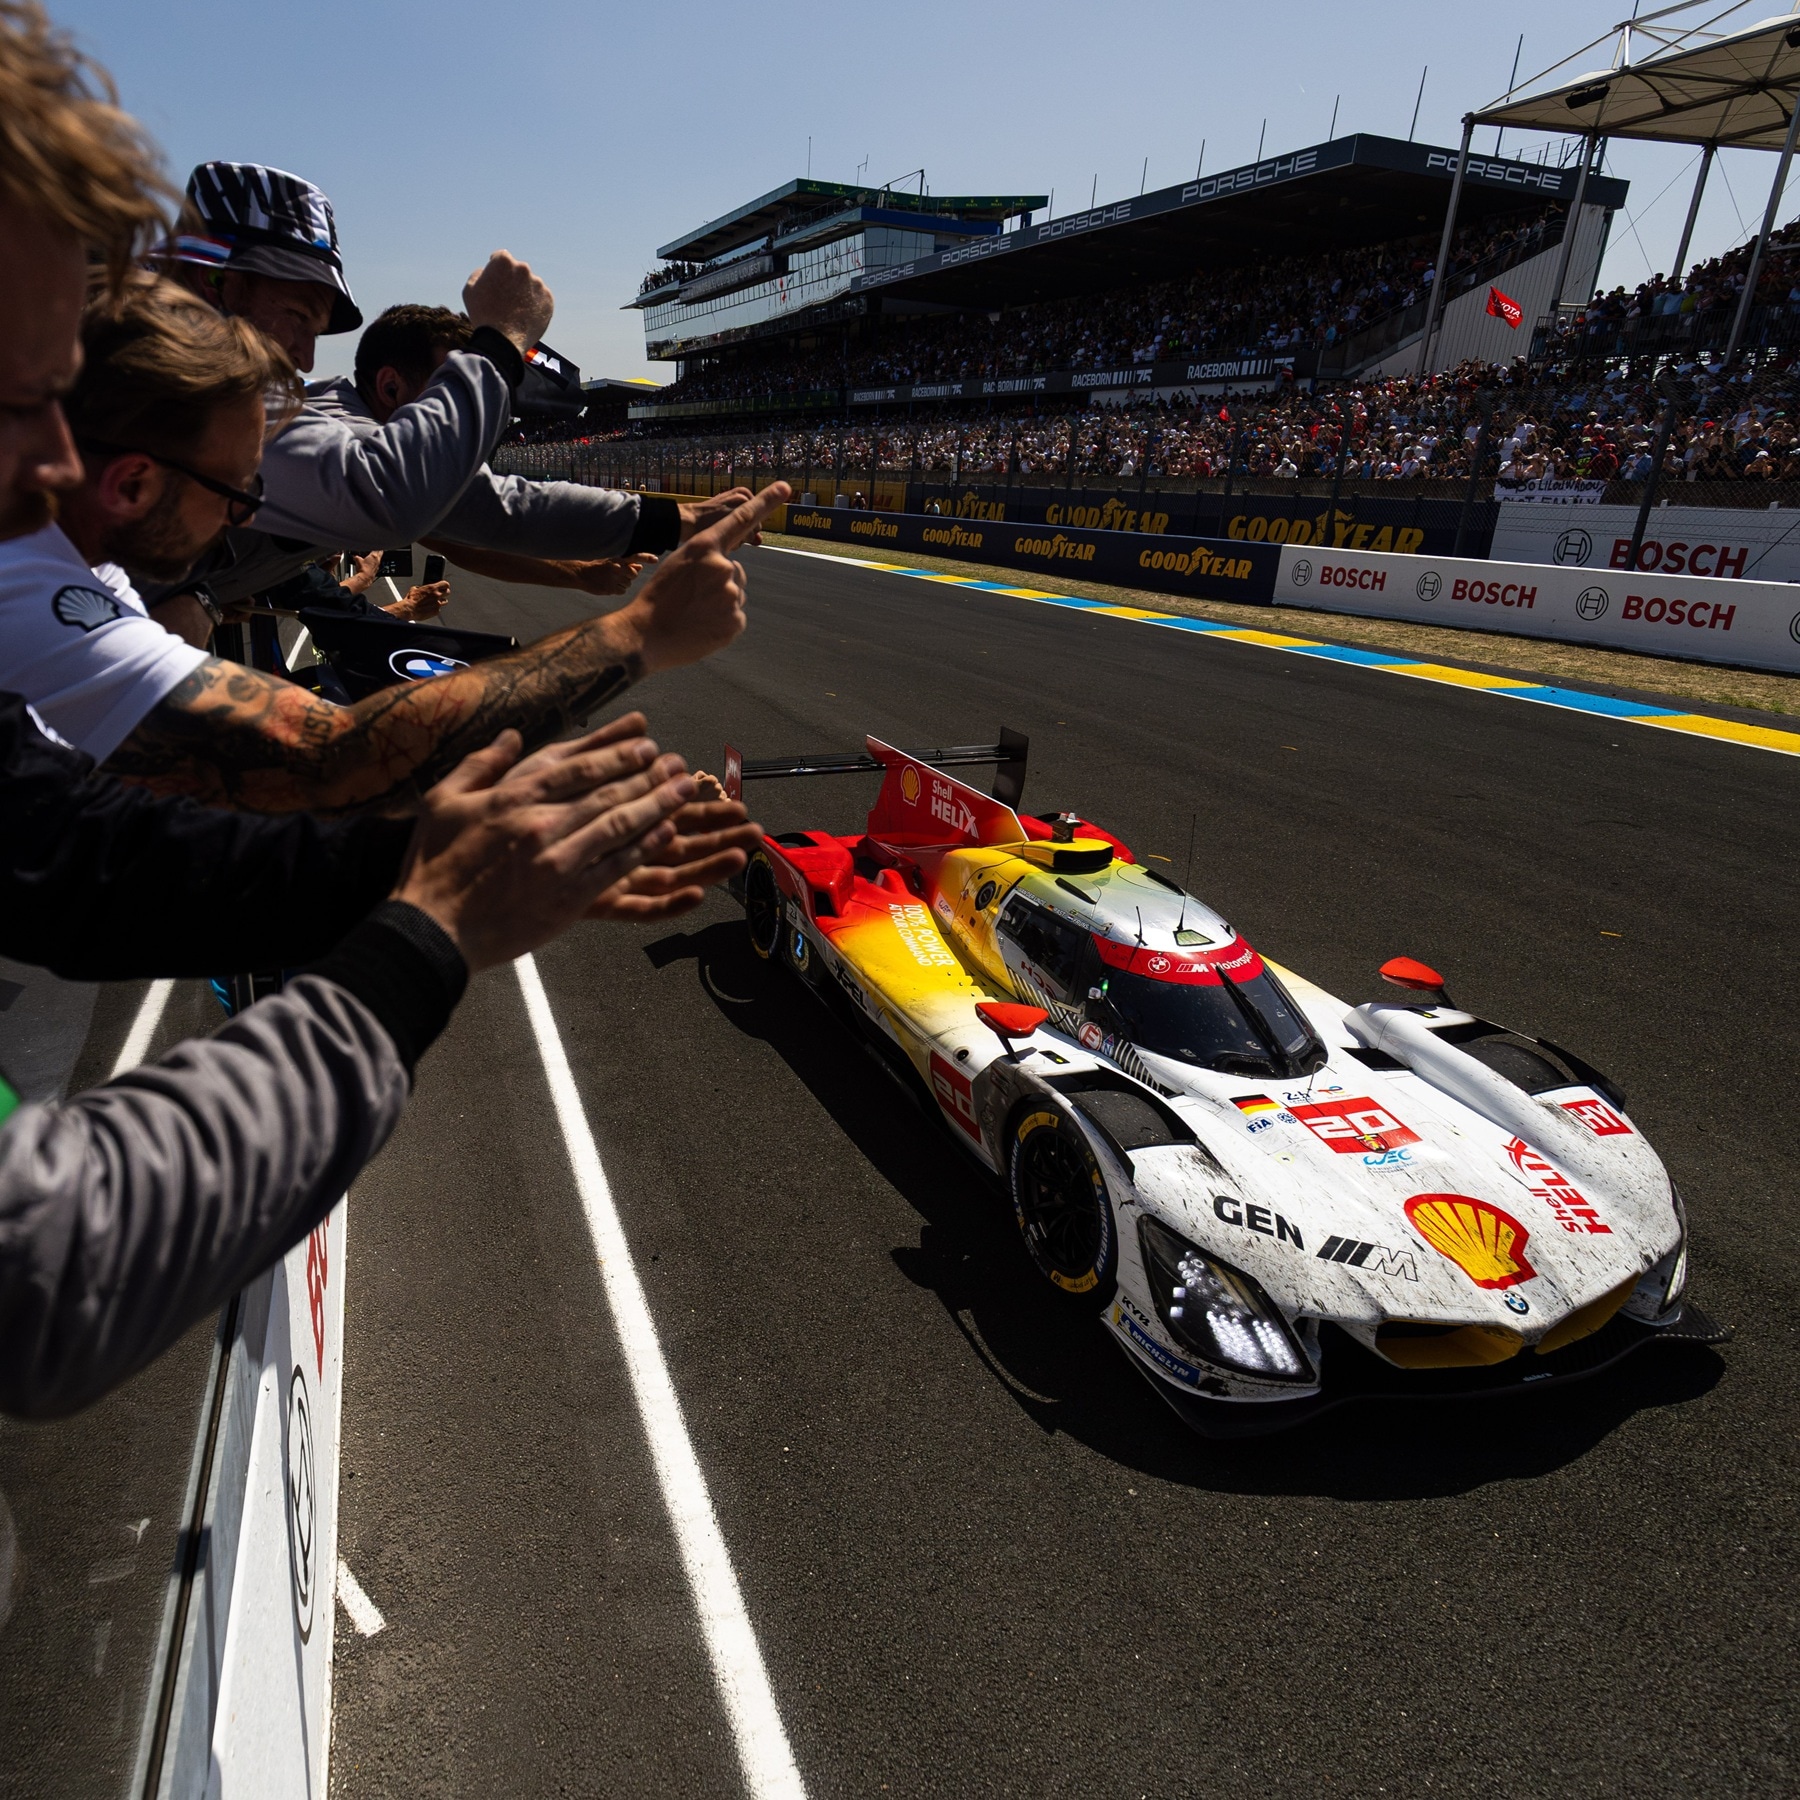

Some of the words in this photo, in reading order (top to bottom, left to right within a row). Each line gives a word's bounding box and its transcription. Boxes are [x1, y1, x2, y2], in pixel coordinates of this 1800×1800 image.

[1181, 150, 1318, 203] PORSCHE
[1425, 153, 1562, 190] PORSCHE
[1037, 203, 1131, 241] PORSCHE
[941, 236, 1011, 265] PORSCHE
[860, 262, 915, 288] PORSCHE
[1071, 372, 1112, 387] RACEBORN
[1136, 368, 1153, 383] 75
[1187, 361, 1241, 379] RACEBORN
[911, 387, 937, 398] RACEBORN
[982, 381, 1015, 394] RACBORN
[1033, 377, 1046, 390] 75
[793, 512, 832, 531] GOODYEAR
[850, 518, 898, 539] GOODYEAR
[922, 525, 983, 548] GOODYEAR
[1227, 510, 1425, 554] GOODYEAR
[1014, 534, 1096, 562] GOODYEAR
[1609, 539, 1748, 579] BOSCH
[1139, 548, 1252, 581] GOODYEAR
[1320, 565, 1387, 591] BOSCH
[1451, 579, 1538, 609] BOSCH
[1621, 595, 1736, 631] BOSCH
[932, 779, 952, 800] Shell
[930, 795, 979, 838] HELIX
[890, 911, 909, 929] YOUR
[903, 904, 930, 927] 100%
[795, 932, 805, 958] 2
[898, 928, 934, 966] COMMAND
[913, 929, 956, 967] POWER
[1210, 948, 1253, 972] Motorsport
[932, 1069, 978, 1125] 20
[1303, 1109, 1403, 1139] 20
[1501, 1136, 1614, 1235] HELIX
[1213, 1194, 1305, 1252] GEN
[1530, 1188, 1583, 1234] Shell
[1131, 1331, 1190, 1379] MICHELIN
